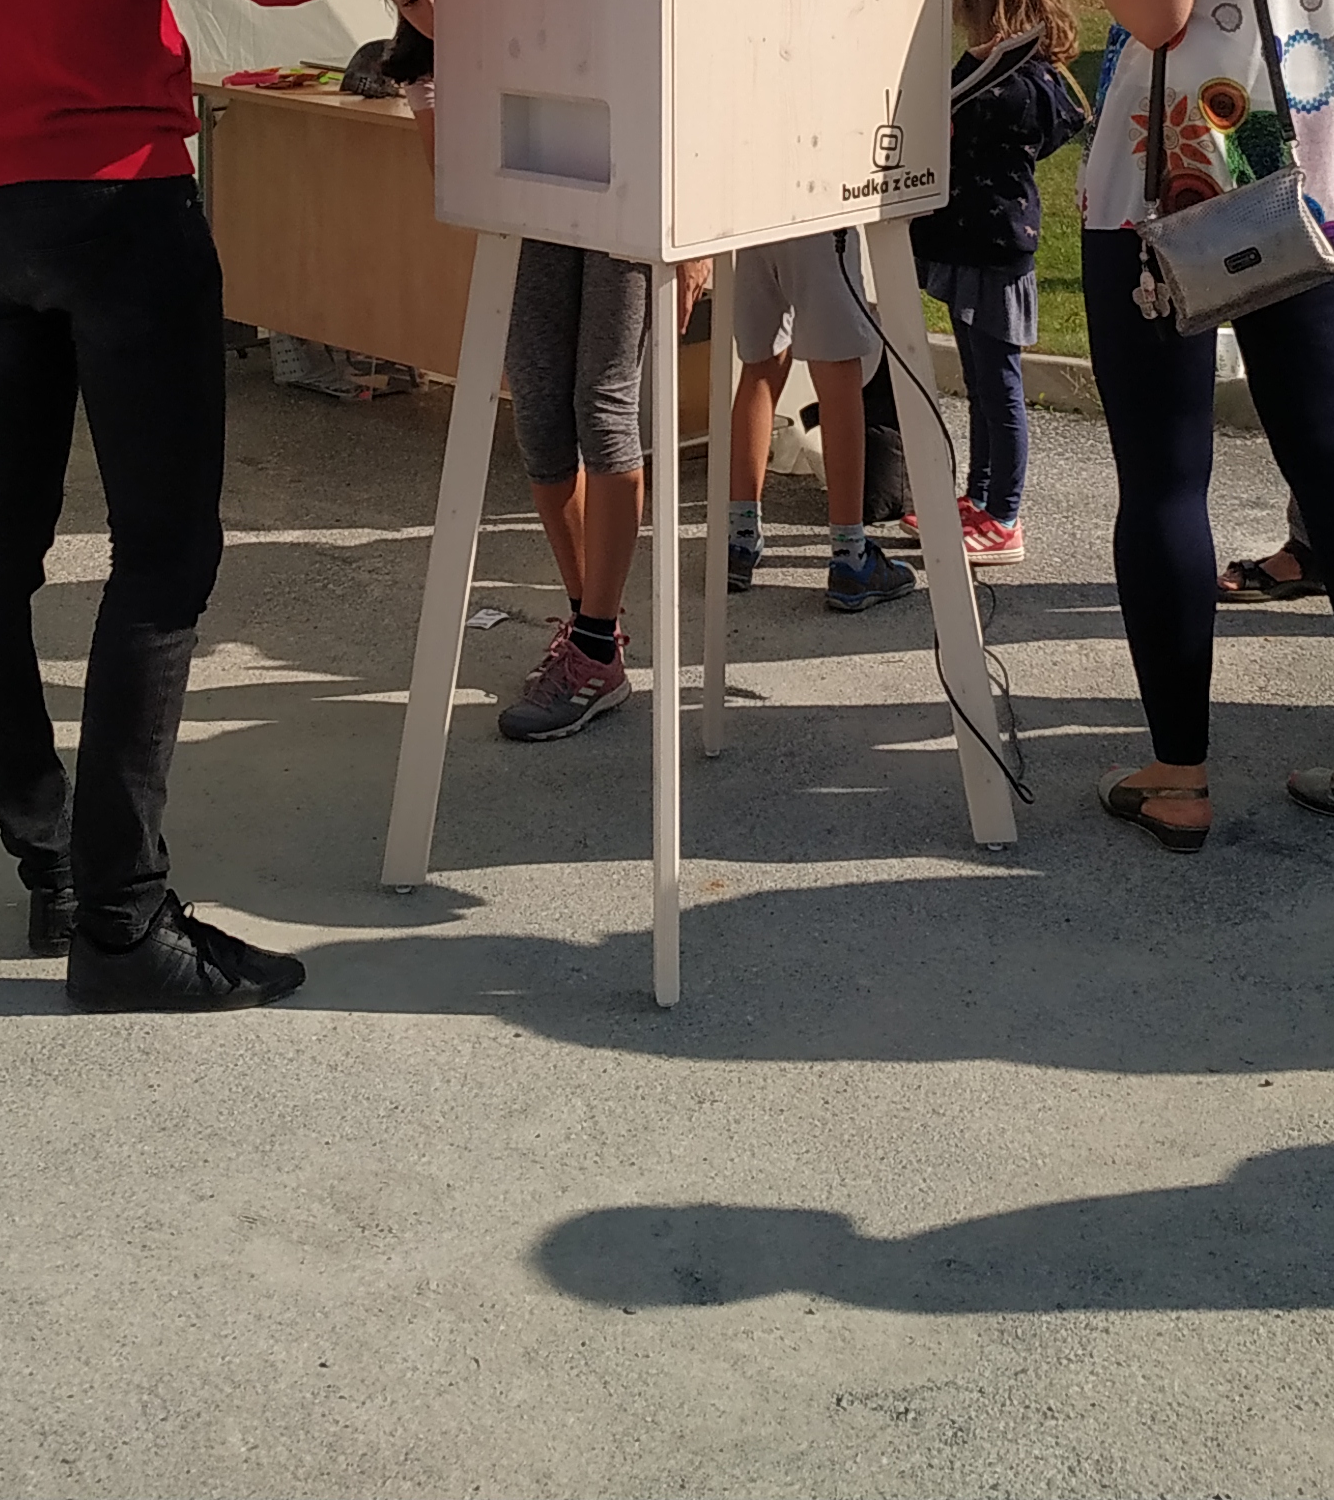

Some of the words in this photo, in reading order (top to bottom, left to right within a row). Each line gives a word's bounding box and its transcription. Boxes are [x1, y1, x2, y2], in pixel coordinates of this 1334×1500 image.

[842, 176, 889, 201] budka
[892, 178, 901, 191] z
[903, 168, 935, 189] čech
